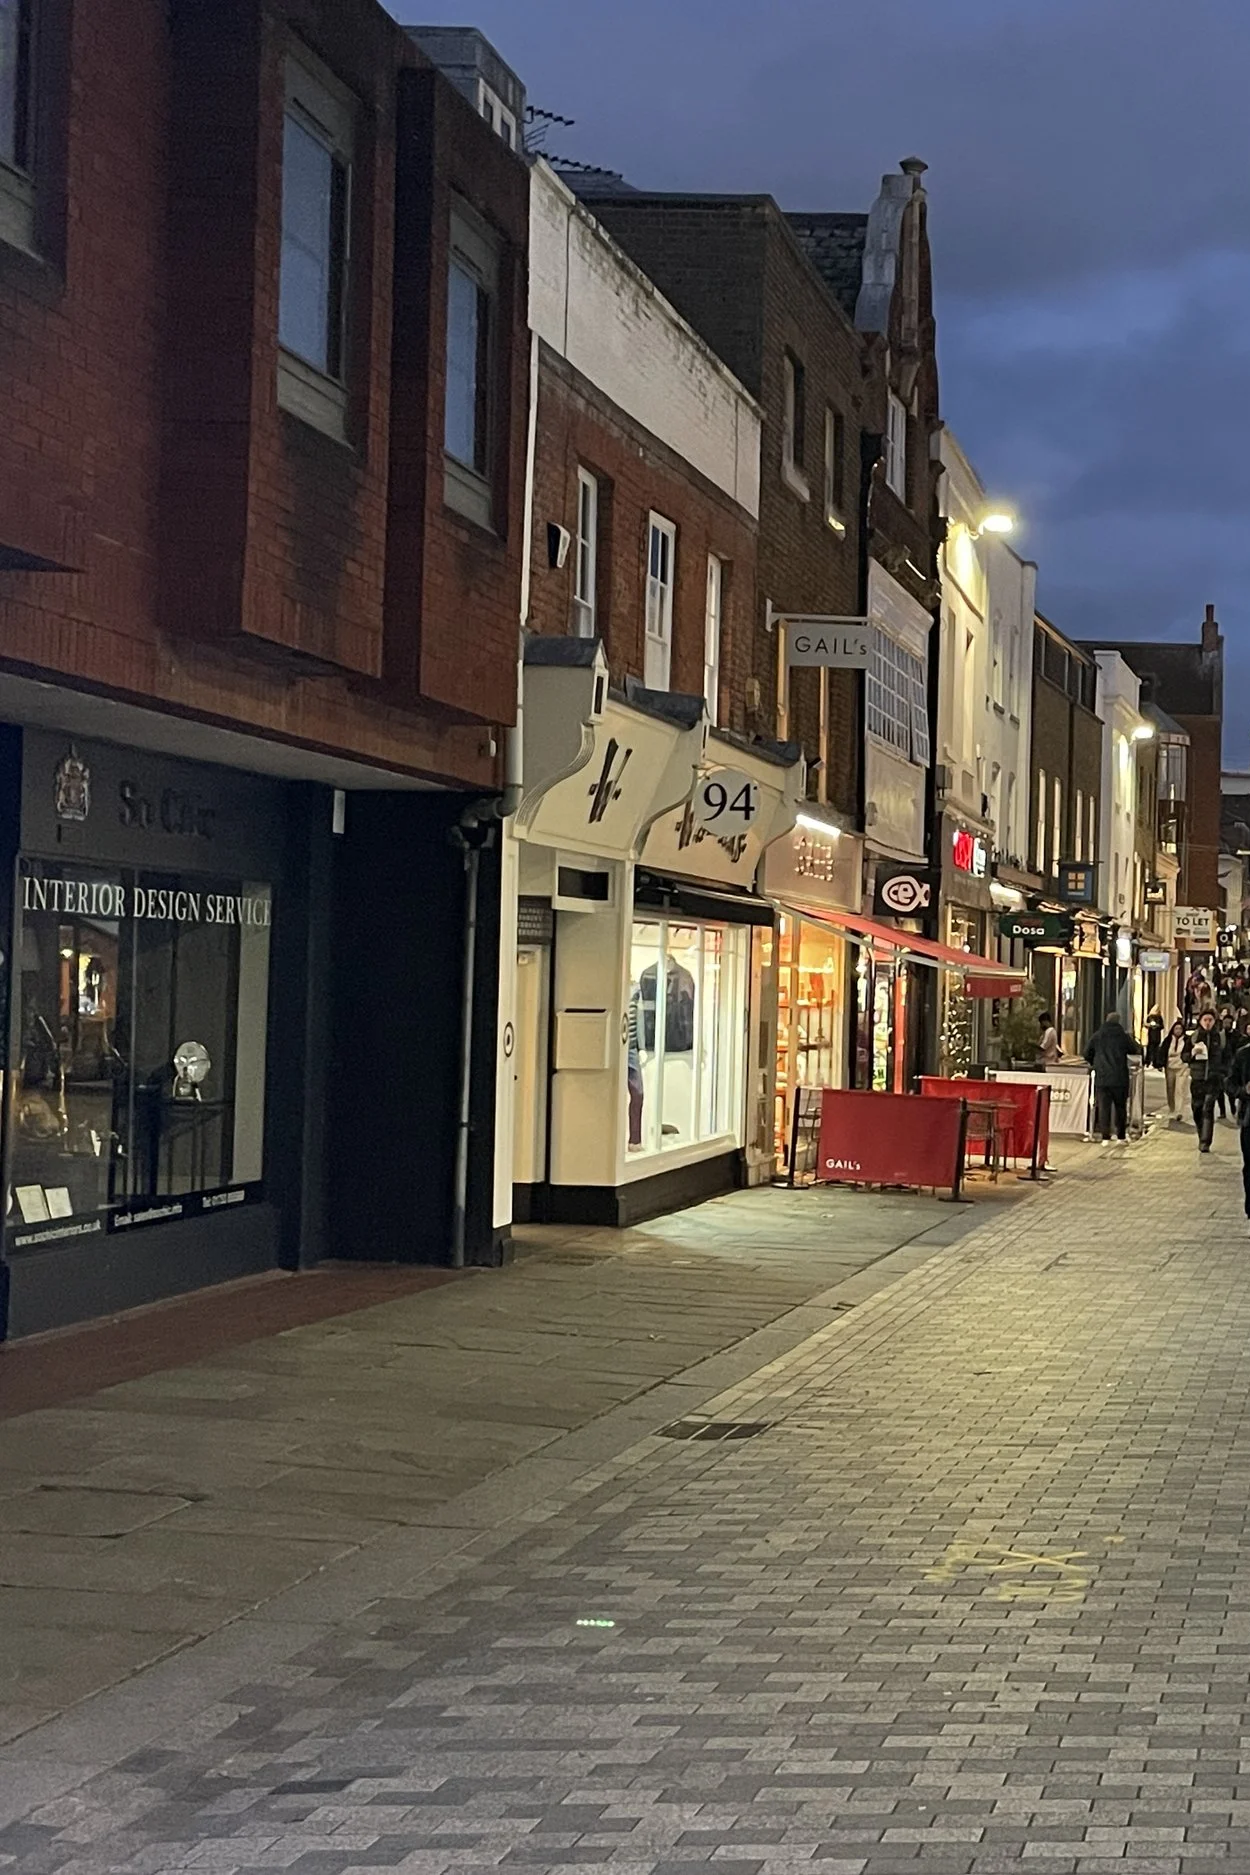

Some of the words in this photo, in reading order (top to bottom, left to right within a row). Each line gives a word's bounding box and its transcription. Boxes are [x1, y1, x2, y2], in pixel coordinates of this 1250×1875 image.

[795, 636, 867, 655] GAIL's
[703, 783, 755, 821] 94
[23, 876, 126, 917] INTERIOR
[133, 887, 201, 922] DESIGN
[206, 894, 272, 926] SERVICE
[1176, 917, 1190, 926] TO
[1193, 918, 1209, 926] LET
[1012, 924, 1045, 936] Dosa
[826, 1158, 861, 1171] GAIL's
